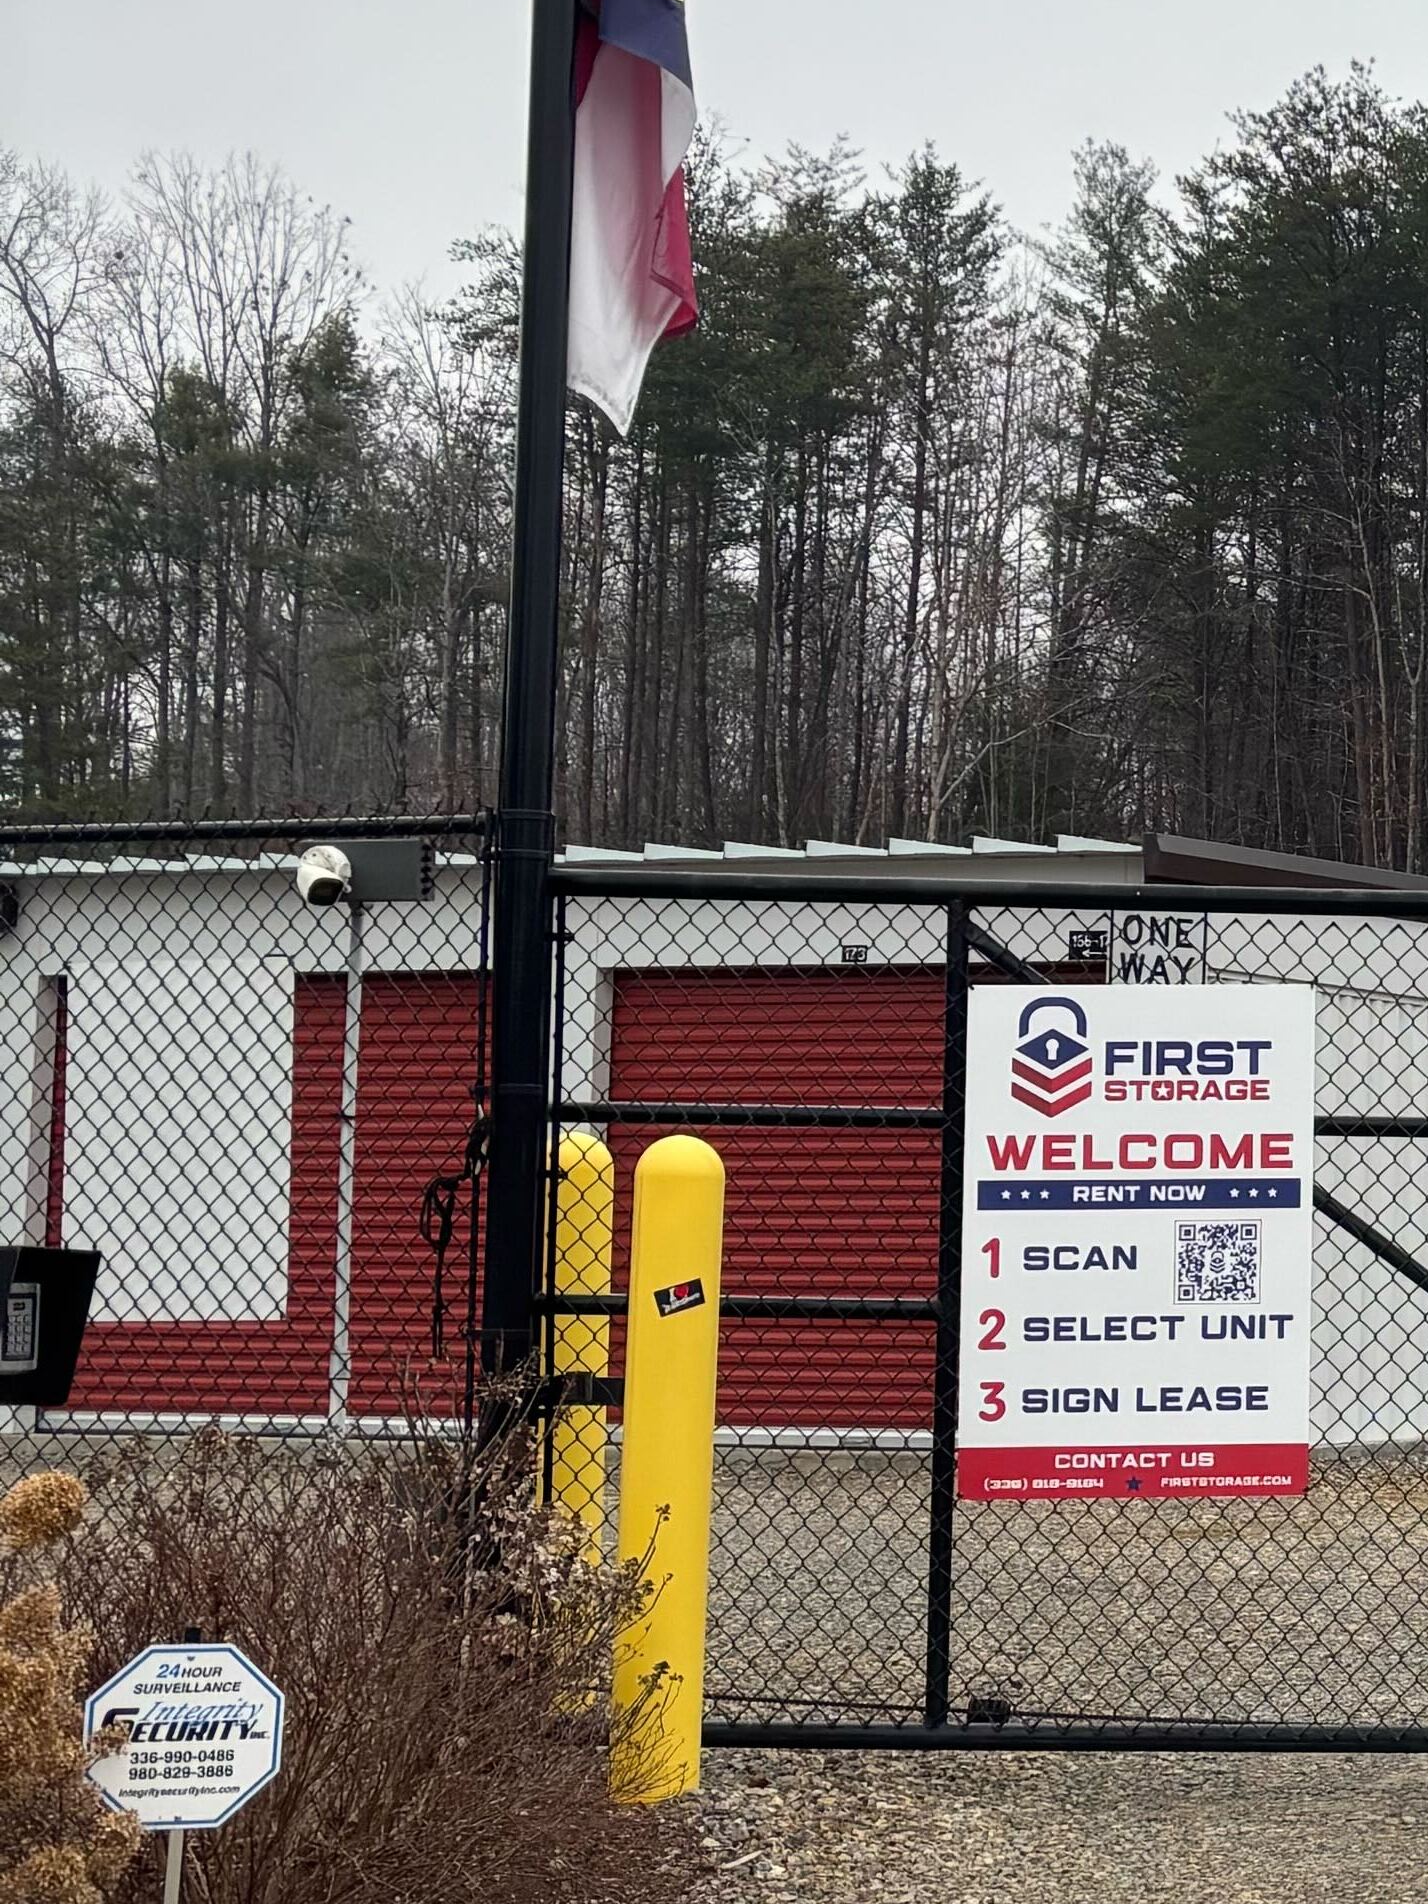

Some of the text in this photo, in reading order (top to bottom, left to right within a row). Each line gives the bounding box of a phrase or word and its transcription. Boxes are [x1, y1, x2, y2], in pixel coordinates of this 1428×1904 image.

[1123, 914, 1194, 948] ONE
[1120, 952, 1195, 984] WAY
[1105, 1041, 1272, 1075] FIRST
[1105, 1080, 1270, 1101] STORAGE
[987, 1134, 1293, 1170] WELCOME
[1073, 1185, 1205, 1201] RENT NOW
[982, 1238, 1136, 1278] 1 SCAN
[978, 1309, 1293, 1350] 2 SELECT UNIT
[979, 1382, 1268, 1421] 3 SIGN LEASE
[1055, 1453, 1214, 1468] CONTACT US
[1161, 1476, 1291, 1487] FIRSTSTORAGE.COM
[156, 1663, 223, 1678] 24 HOUR
[133, 1681, 242, 1695] SURVEILLANCE
[141, 1699, 262, 1725] Integrity
[130, 1749, 235, 1764] 336-990-0486
